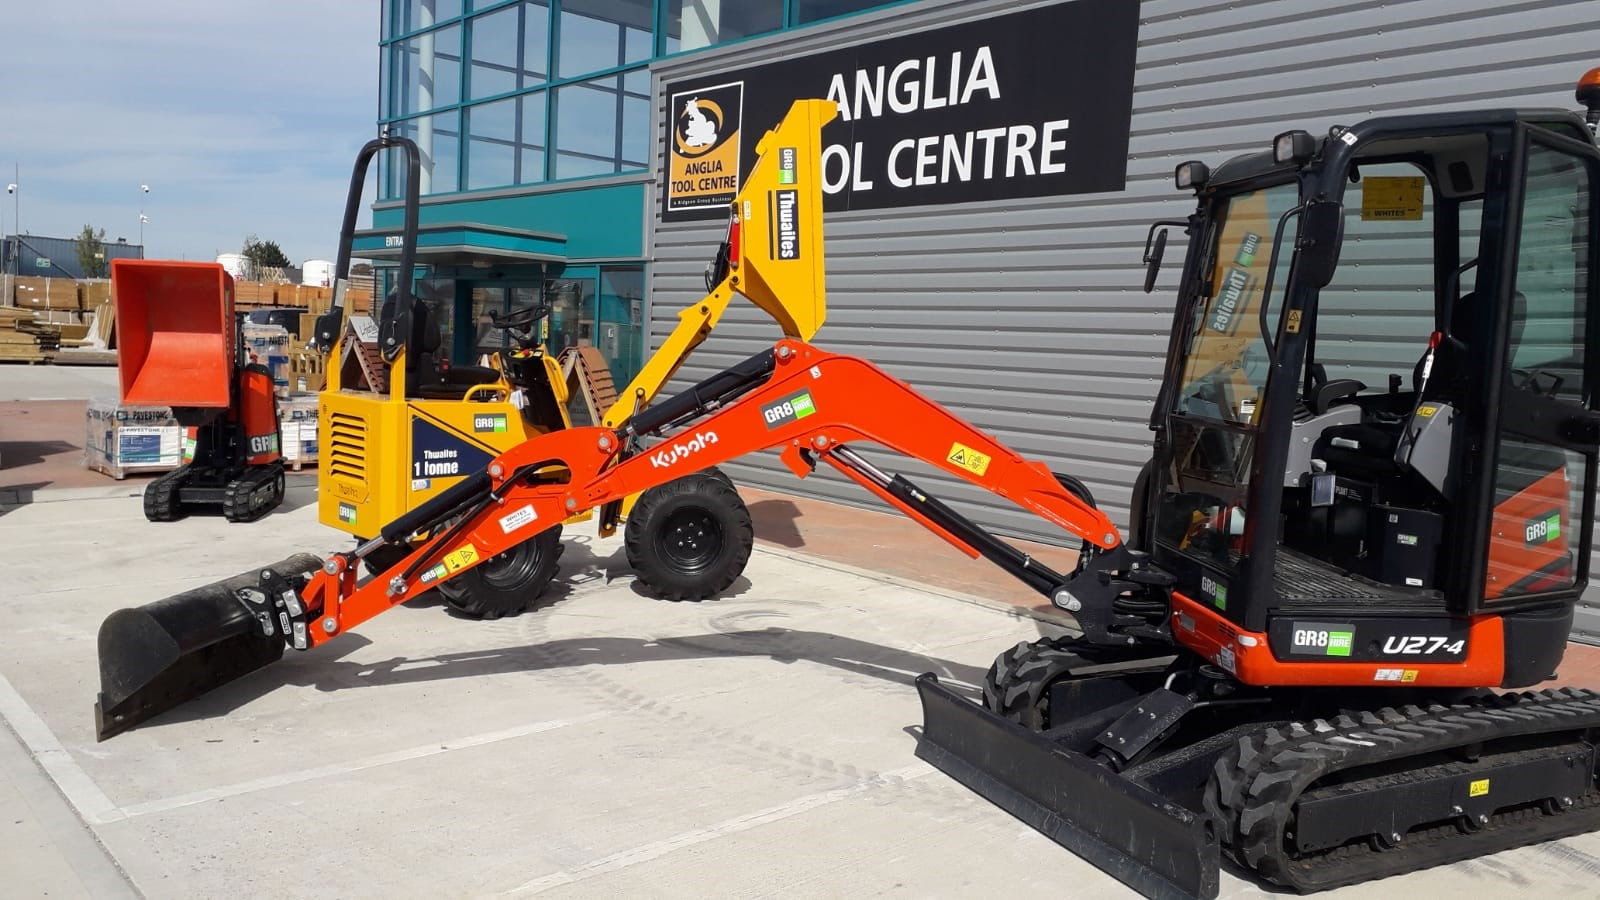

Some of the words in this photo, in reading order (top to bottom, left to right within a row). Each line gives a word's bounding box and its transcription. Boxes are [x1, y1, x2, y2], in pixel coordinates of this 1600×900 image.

[826, 46, 1001, 122] ANGLIA
[821, 142, 873, 194] OL
[888, 119, 1069, 188] CENTRE
[685, 160, 723, 176] ANGLIA
[672, 180, 696, 193] TOOL
[698, 175, 737, 191] CENTRE
[780, 191, 796, 258] Thwaites
[385, 235, 404, 247] ENTRA
[764, 402, 794, 424] GR8
[475, 417, 494, 429] GR8
[423, 449, 458, 460] Thwaites
[650, 431, 719, 468] Kubota
[414, 461, 421, 477] 1
[424, 461, 459, 476] tonne
[1526, 520, 1547, 542] GR8
[421, 569, 437, 582] GR8
[1201, 576, 1216, 596] GR8
[1294, 629, 1329, 647] GR8
[1329, 637, 1351, 648] HIRE
[1383, 636, 1465, 655] U27-4
